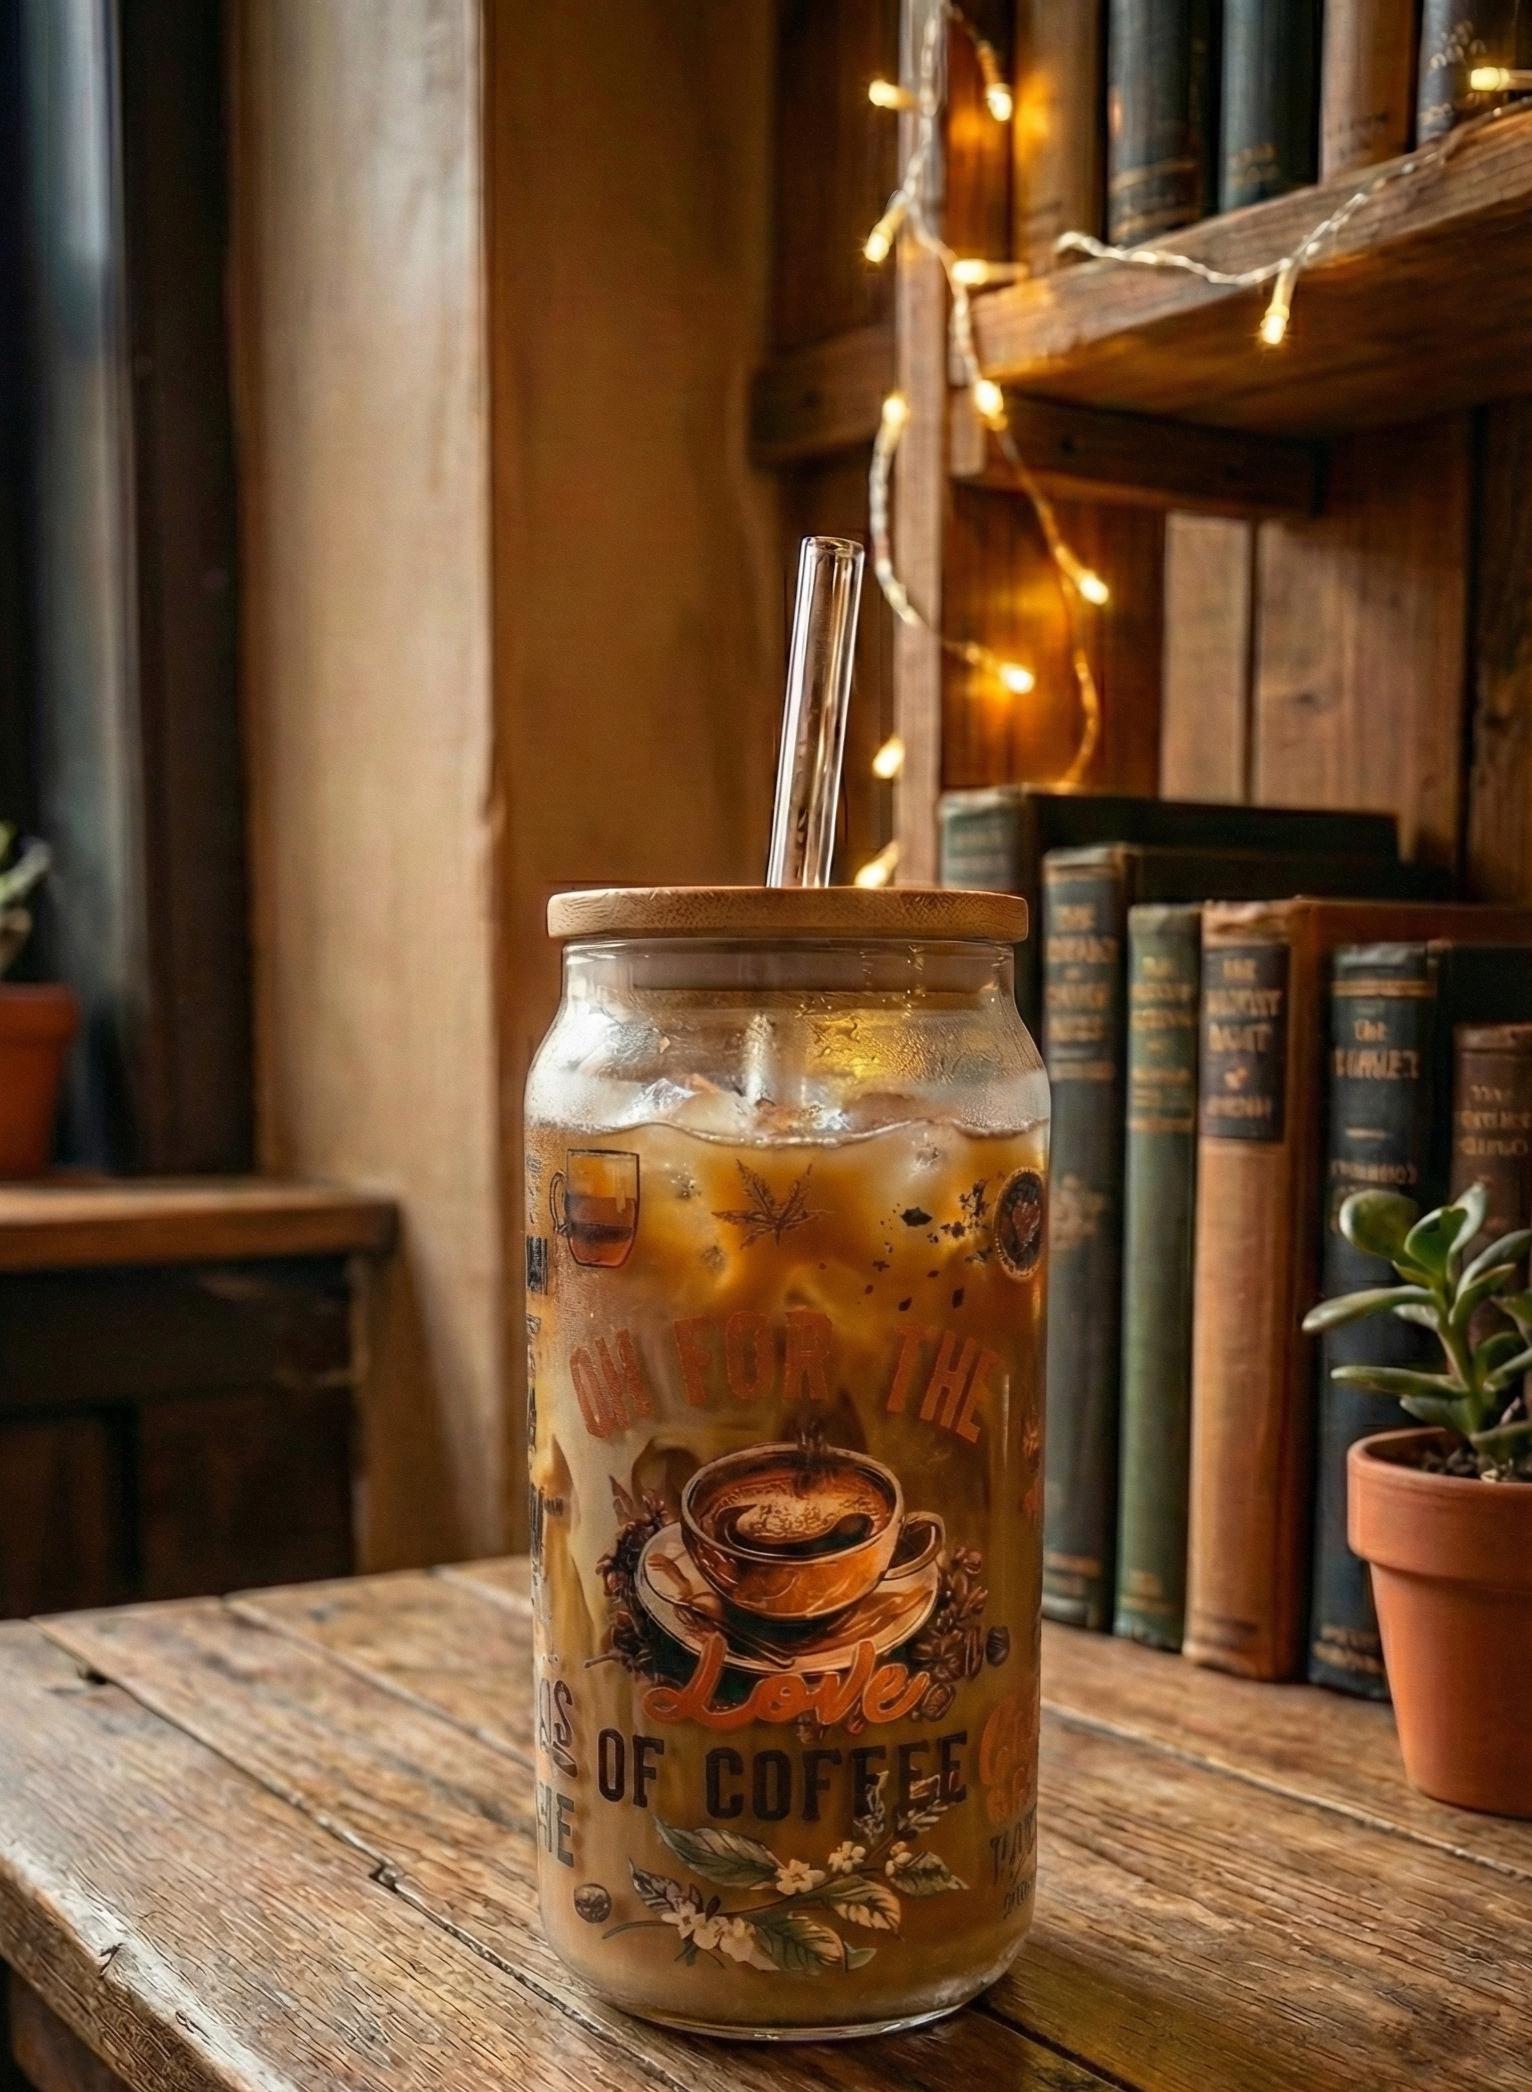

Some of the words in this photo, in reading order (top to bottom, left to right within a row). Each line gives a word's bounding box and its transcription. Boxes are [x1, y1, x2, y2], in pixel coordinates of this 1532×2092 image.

[673, 1309, 835, 1406] FOR
[886, 1323, 1000, 1444] THE
[641, 1632, 931, 1730] Love
[598, 1728, 665, 1809] OF
[705, 1731, 968, 1822] COFFEE
